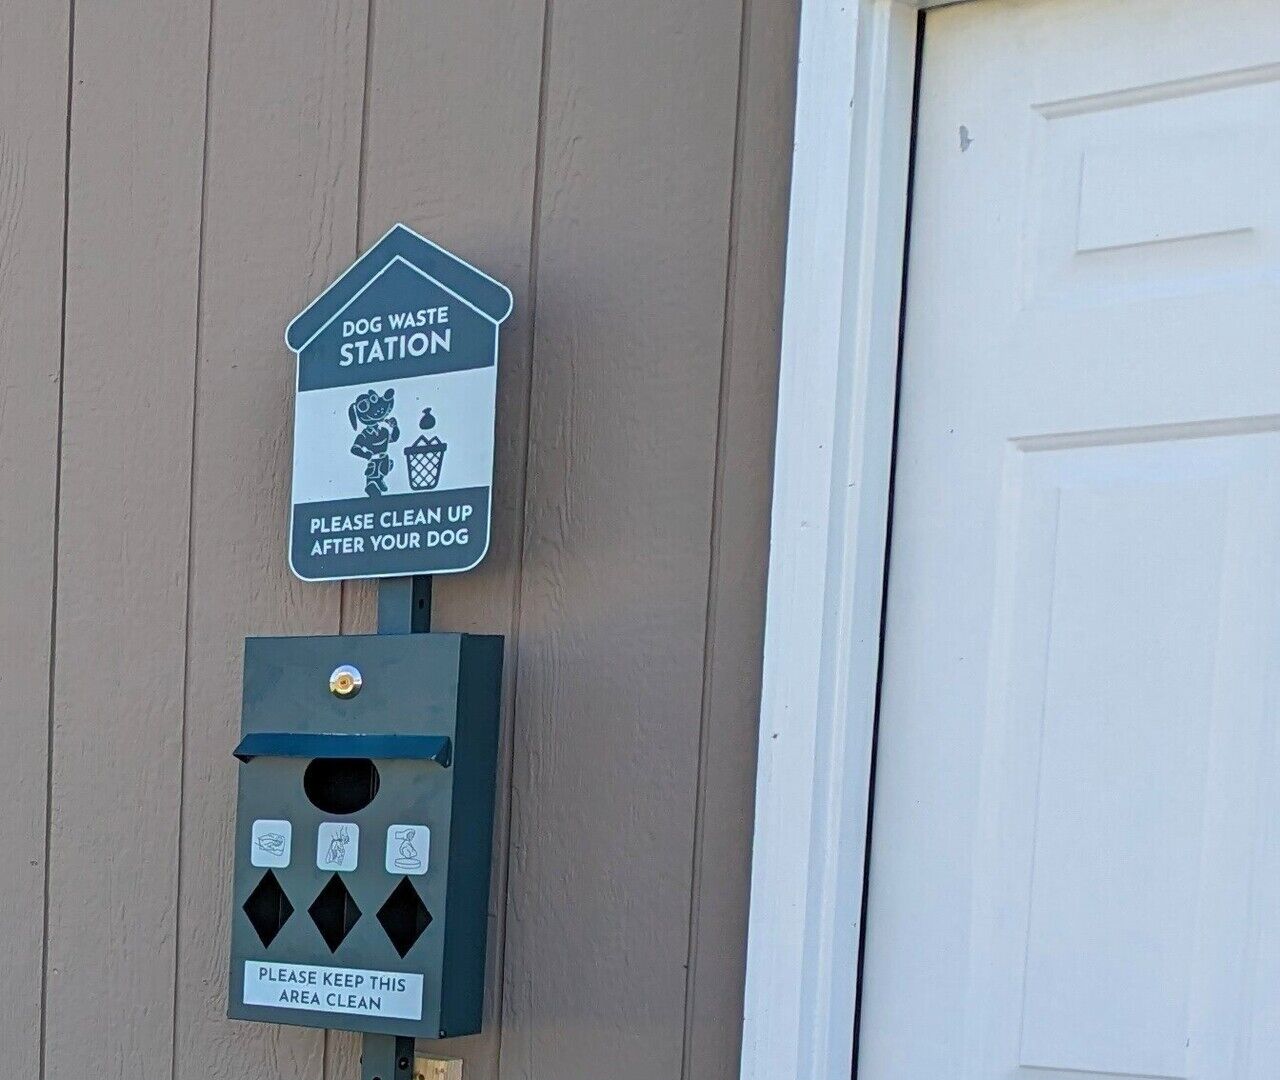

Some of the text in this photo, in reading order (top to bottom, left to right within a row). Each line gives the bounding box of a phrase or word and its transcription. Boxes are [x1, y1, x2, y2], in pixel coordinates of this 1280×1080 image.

[343, 306, 449, 338] DOG WASTE
[339, 328, 451, 367] STATION
[310, 504, 473, 534] PLEASE CLEAN UP
[310, 528, 469, 556] AFTER YOUR DOG
[258, 967, 407, 992] PLEASE KEEP THIS
[278, 989, 382, 1011] AREA CLEAN
